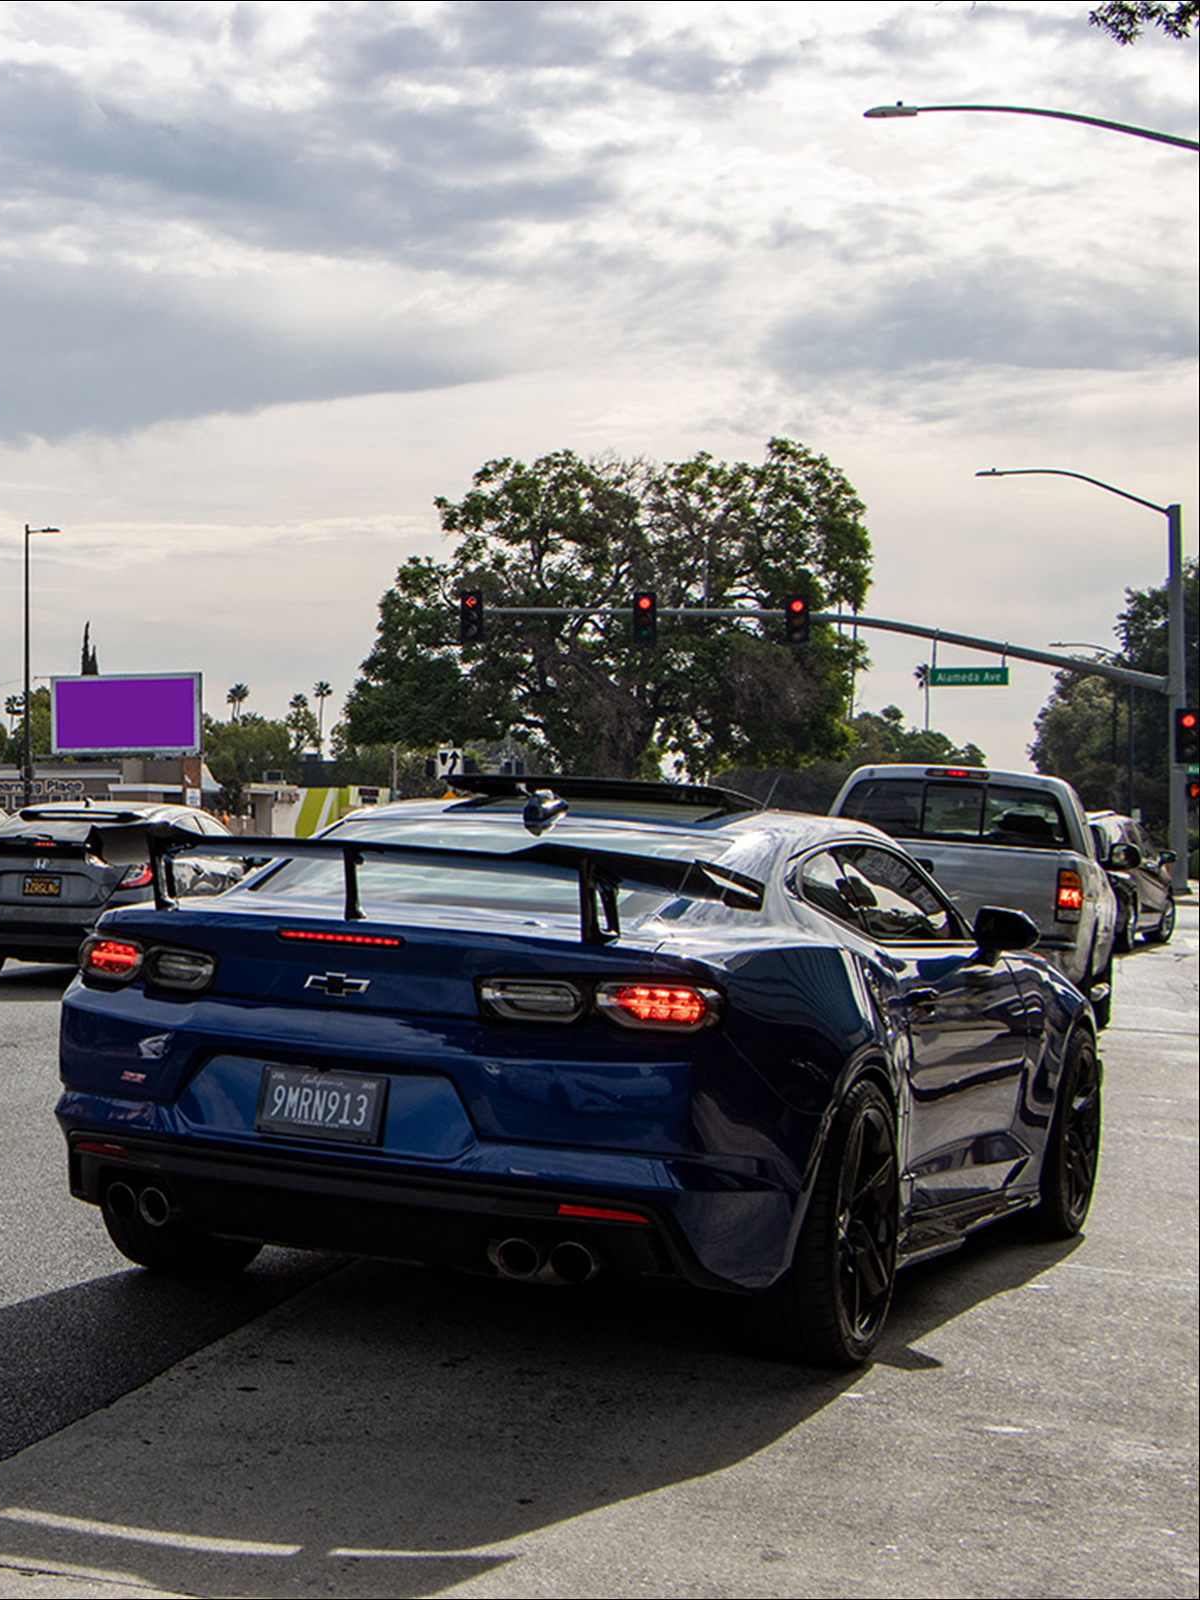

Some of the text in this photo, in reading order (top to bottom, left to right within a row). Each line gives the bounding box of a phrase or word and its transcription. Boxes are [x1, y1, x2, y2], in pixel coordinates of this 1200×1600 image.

[936, 672, 1002, 683] Alameda Ave
[46, 780, 83, 793] Place
[301, 1074, 348, 1088] California
[270, 1084, 368, 1126] 9MRN913
